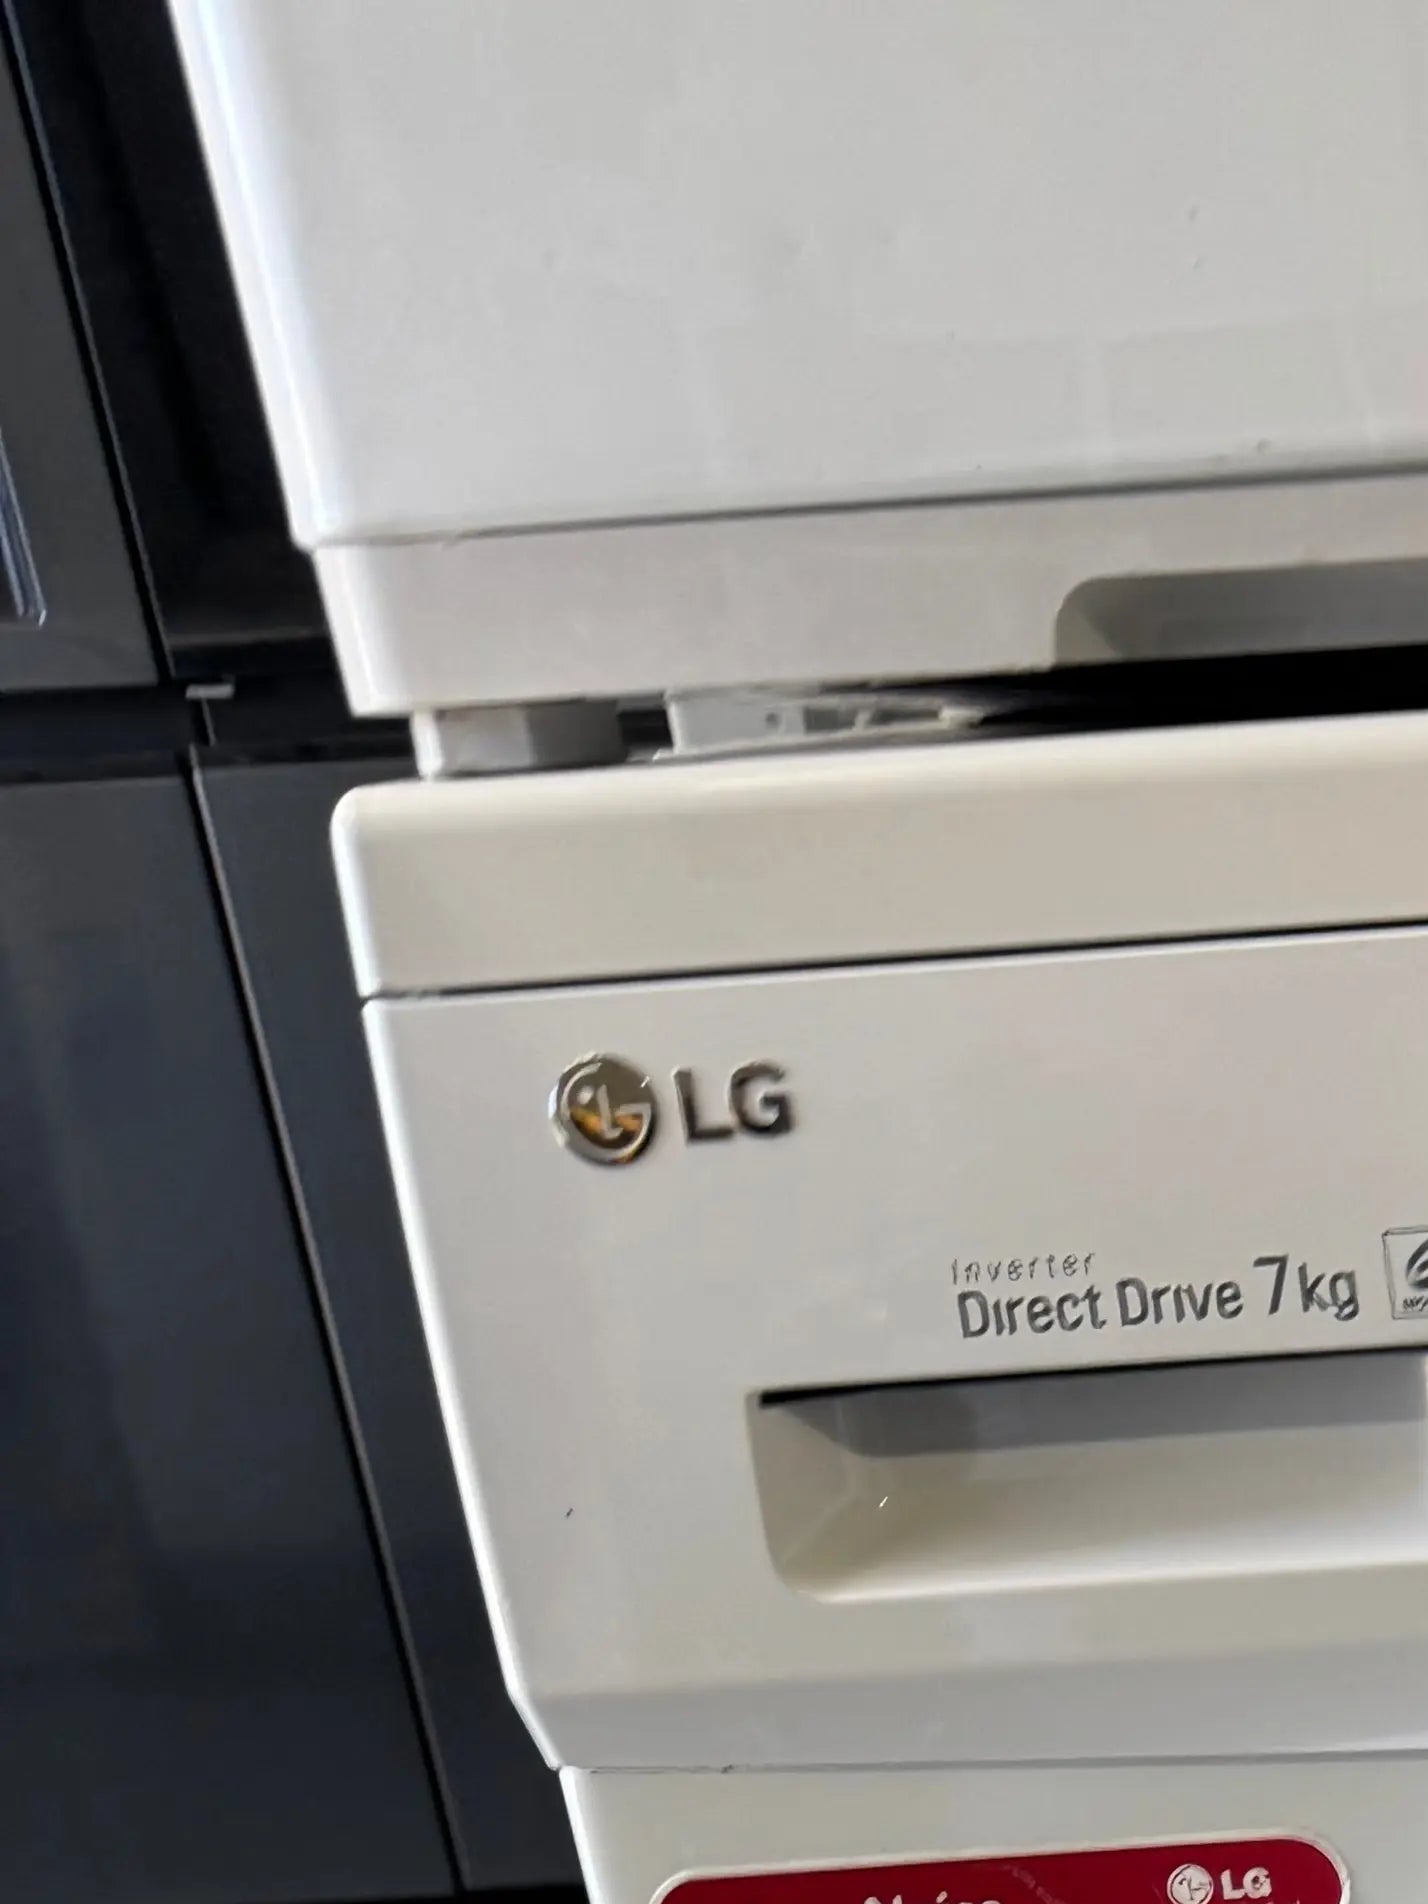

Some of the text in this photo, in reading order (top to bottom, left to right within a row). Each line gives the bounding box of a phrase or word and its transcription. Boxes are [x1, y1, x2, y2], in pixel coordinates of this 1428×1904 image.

[670, 1059, 795, 1143] LG
[951, 1252, 1096, 1286] Inverter
[957, 1284, 1107, 1339] Direct
[1115, 1276, 1244, 1329] Drive
[1221, 1866, 1273, 1900] LG
